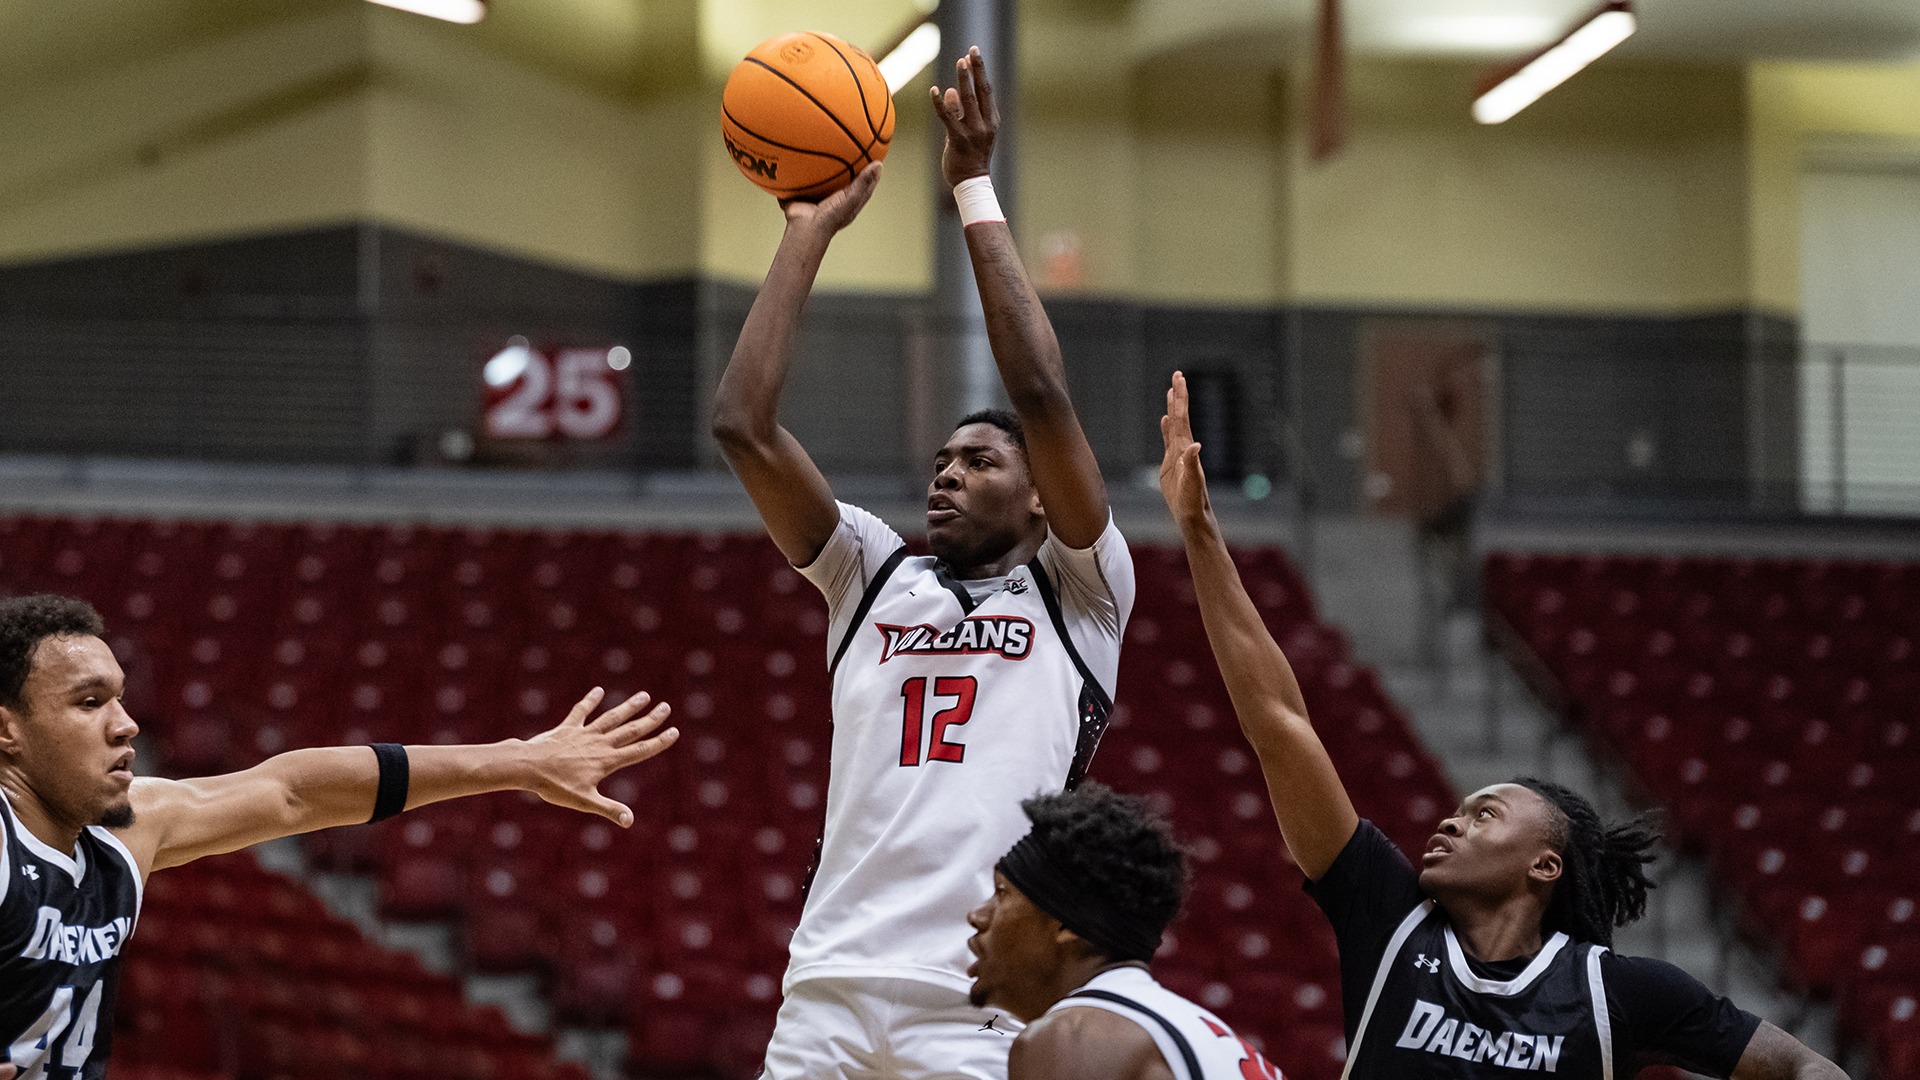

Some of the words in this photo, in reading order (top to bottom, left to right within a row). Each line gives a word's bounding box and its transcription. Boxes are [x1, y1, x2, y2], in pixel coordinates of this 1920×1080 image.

[486, 347, 622, 437] 25
[880, 616, 1034, 662] VULCANS
[899, 675, 978, 767] 12
[20, 905, 131, 966] DAEMEN
[8, 979, 104, 1080] 44
[1395, 998, 1565, 1073] DAEMEN
